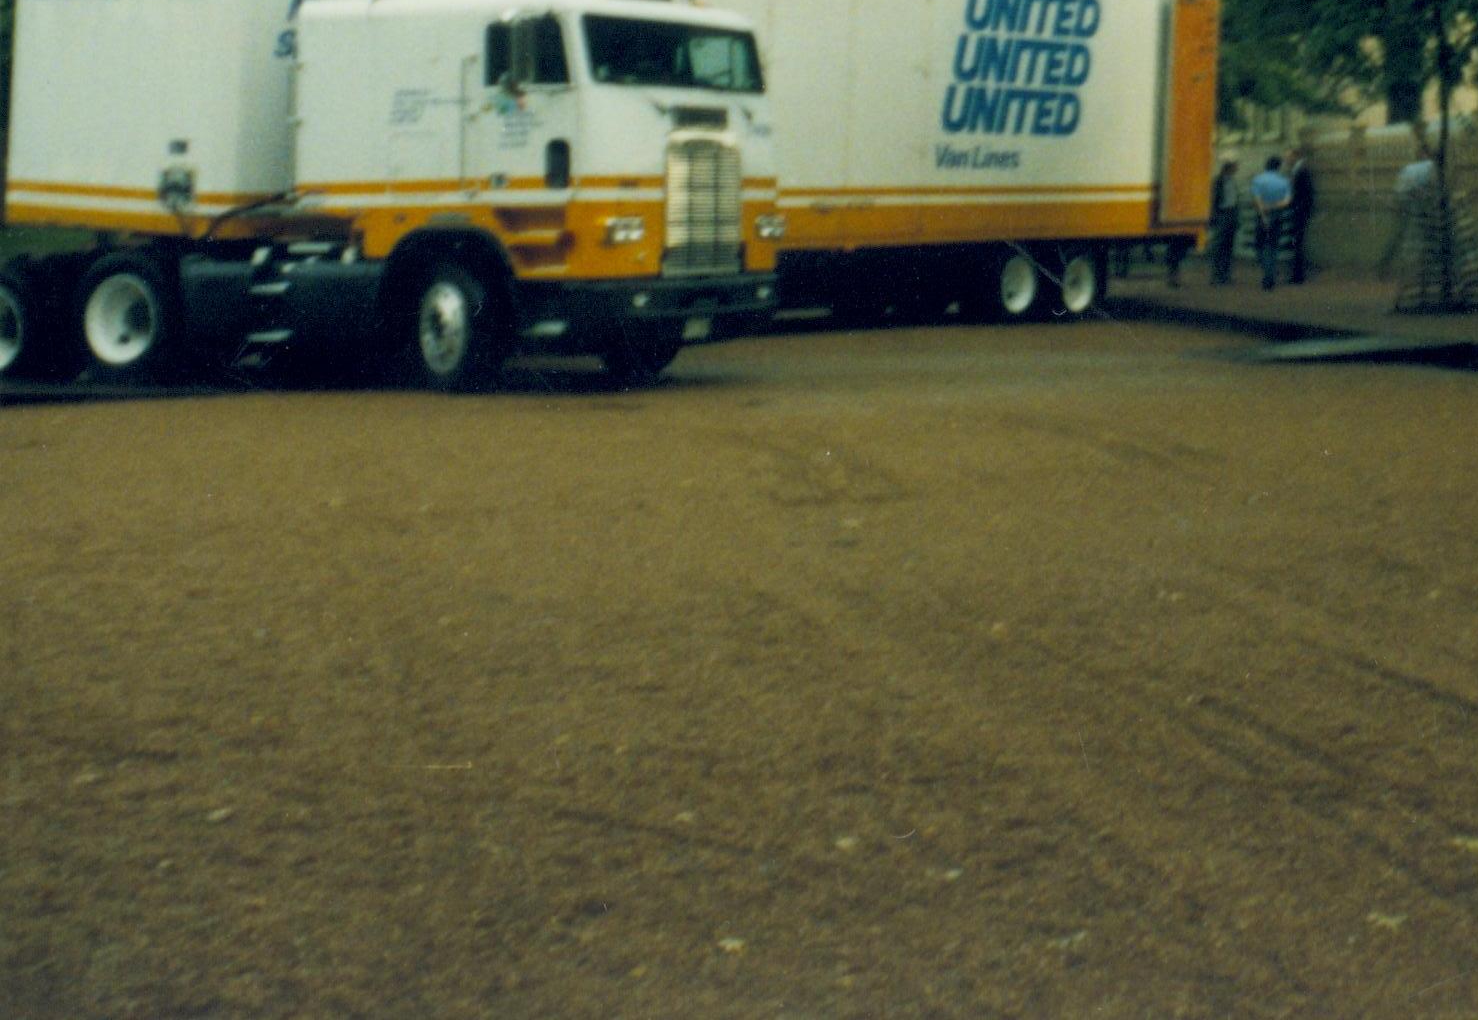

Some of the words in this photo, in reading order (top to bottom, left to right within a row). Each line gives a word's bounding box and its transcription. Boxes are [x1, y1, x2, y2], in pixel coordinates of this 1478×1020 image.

[953, 34, 1091, 87] UNITED
[941, 85, 1081, 136] UNITED
[935, 143, 967, 169] Van
[971, 145, 1020, 169] Lines
